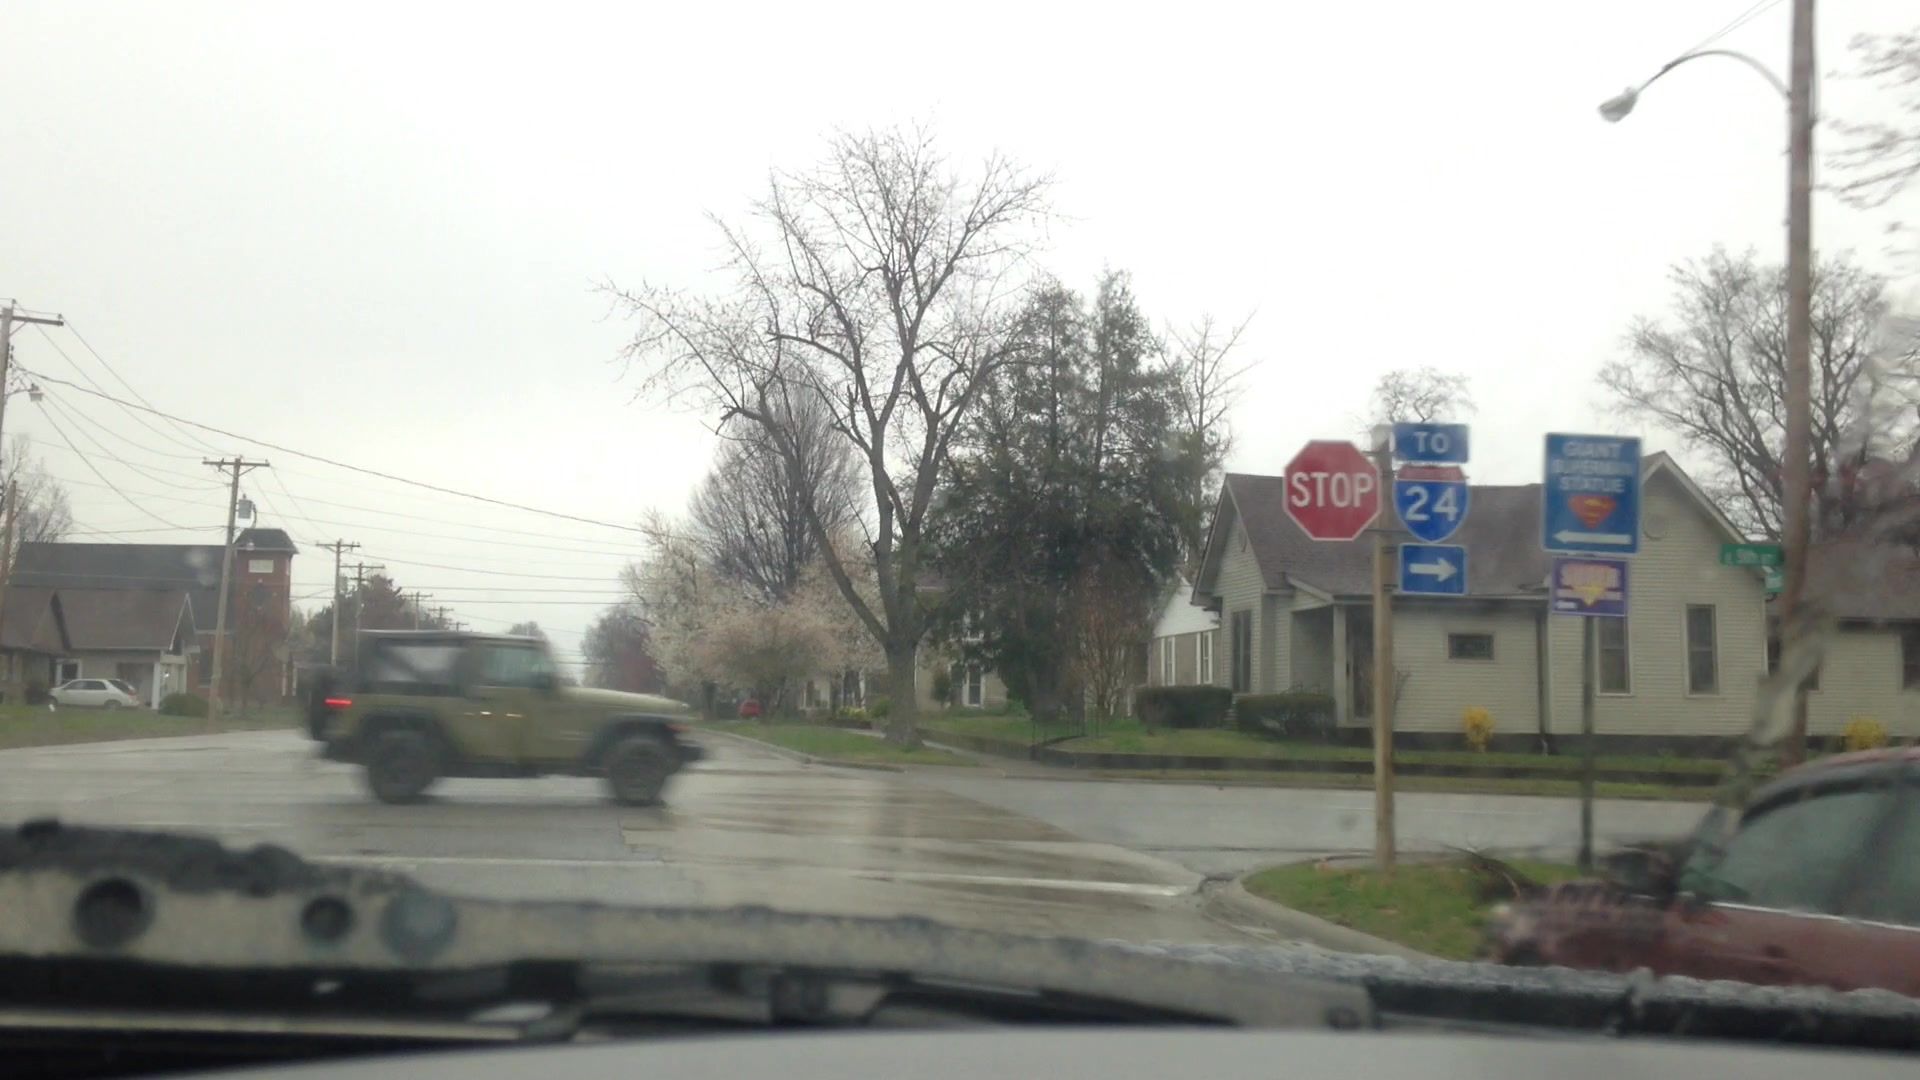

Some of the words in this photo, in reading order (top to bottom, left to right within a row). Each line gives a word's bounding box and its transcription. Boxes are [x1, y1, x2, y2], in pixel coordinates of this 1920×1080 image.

[1413, 431, 1449, 453] TO
[1564, 441, 1621, 458] GIANT
[1291, 472, 1374, 508] STOP
[1560, 476, 1624, 493] STATUE
[1405, 486, 1459, 522] 24
